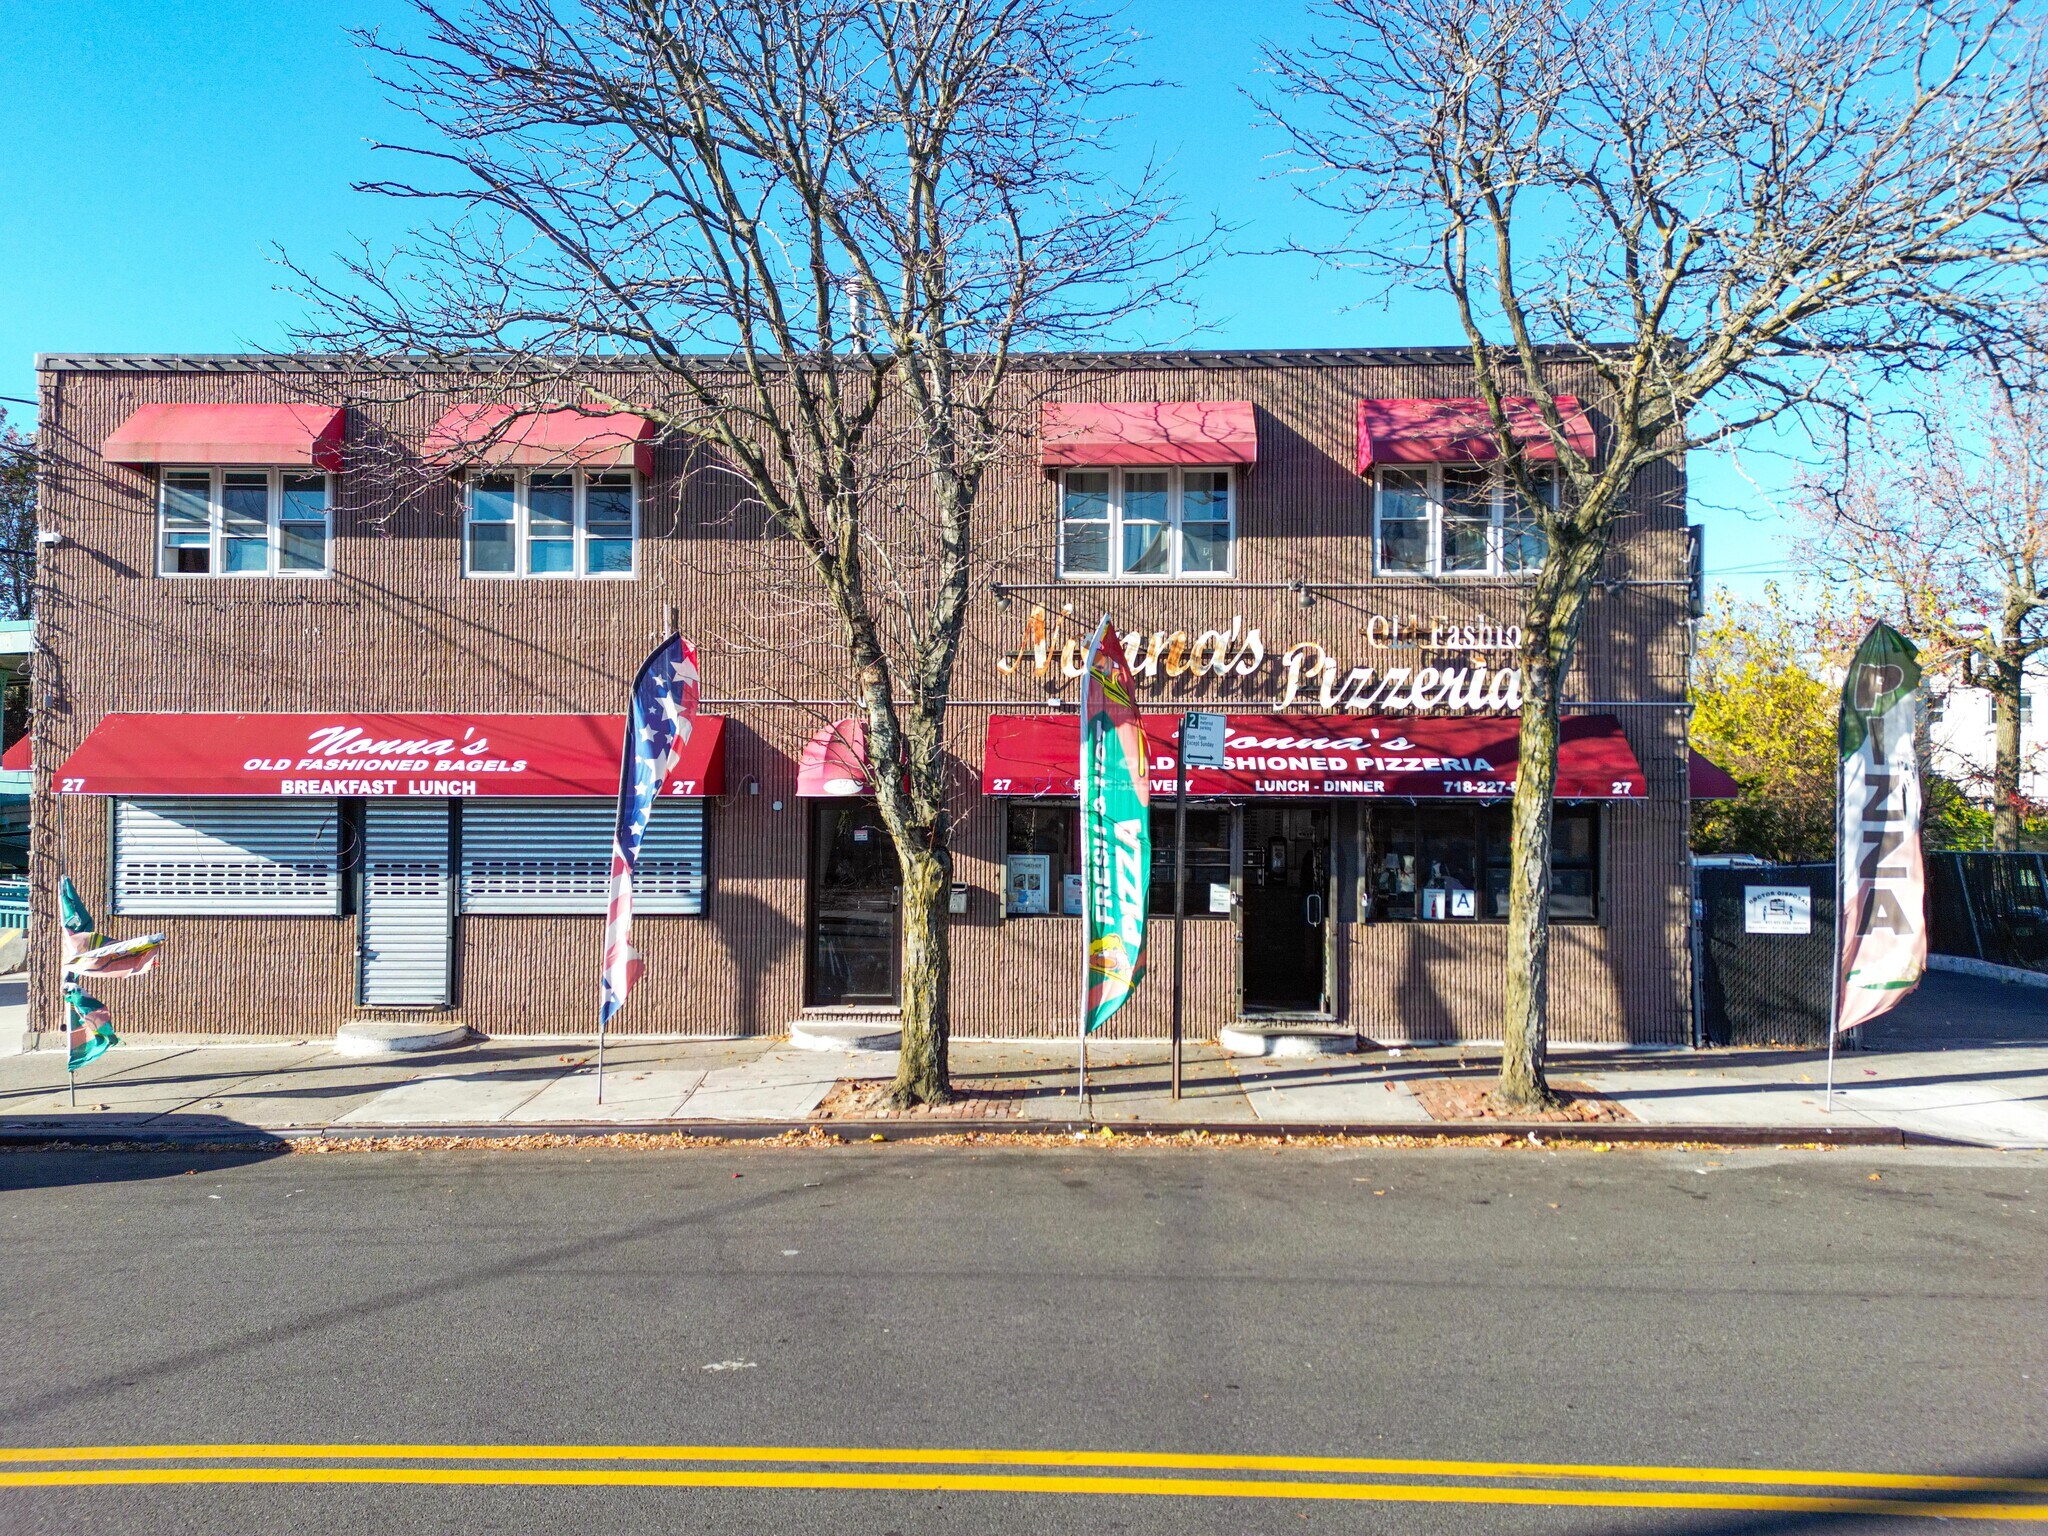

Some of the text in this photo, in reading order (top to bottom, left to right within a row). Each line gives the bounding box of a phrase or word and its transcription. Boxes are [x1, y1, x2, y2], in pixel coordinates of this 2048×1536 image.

[1367, 614, 1522, 649] Old Fashio
[1273, 642, 1523, 711] Pizzeria
[1188, 713, 1196, 727] 2
[307, 726, 489, 756] Nonna's
[1200, 741, 1215, 749] Sunday
[243, 758, 528, 772] OLD FASHIONED BAGELS
[1356, 757, 1495, 772] PIZZERIA
[62, 778, 85, 792] 27
[281, 779, 476, 795] BREAKFAST LUNCH
[672, 780, 696, 795] 27
[992, 778, 1012, 791] 27
[1255, 780, 1310, 792] LUNCH
[1323, 780, 1385, 793] DINNER
[1444, 780, 1517, 793] 718-227-8
[1612, 781, 1633, 794] 27
[1853, 663, 1914, 937] PIZZA
[1093, 826, 1115, 926] FRESH
[1113, 818, 1143, 947] PIZZA
[1457, 893, 1470, 908] A
[1749, 890, 1809, 906] DOCTOR DISPOSAL
